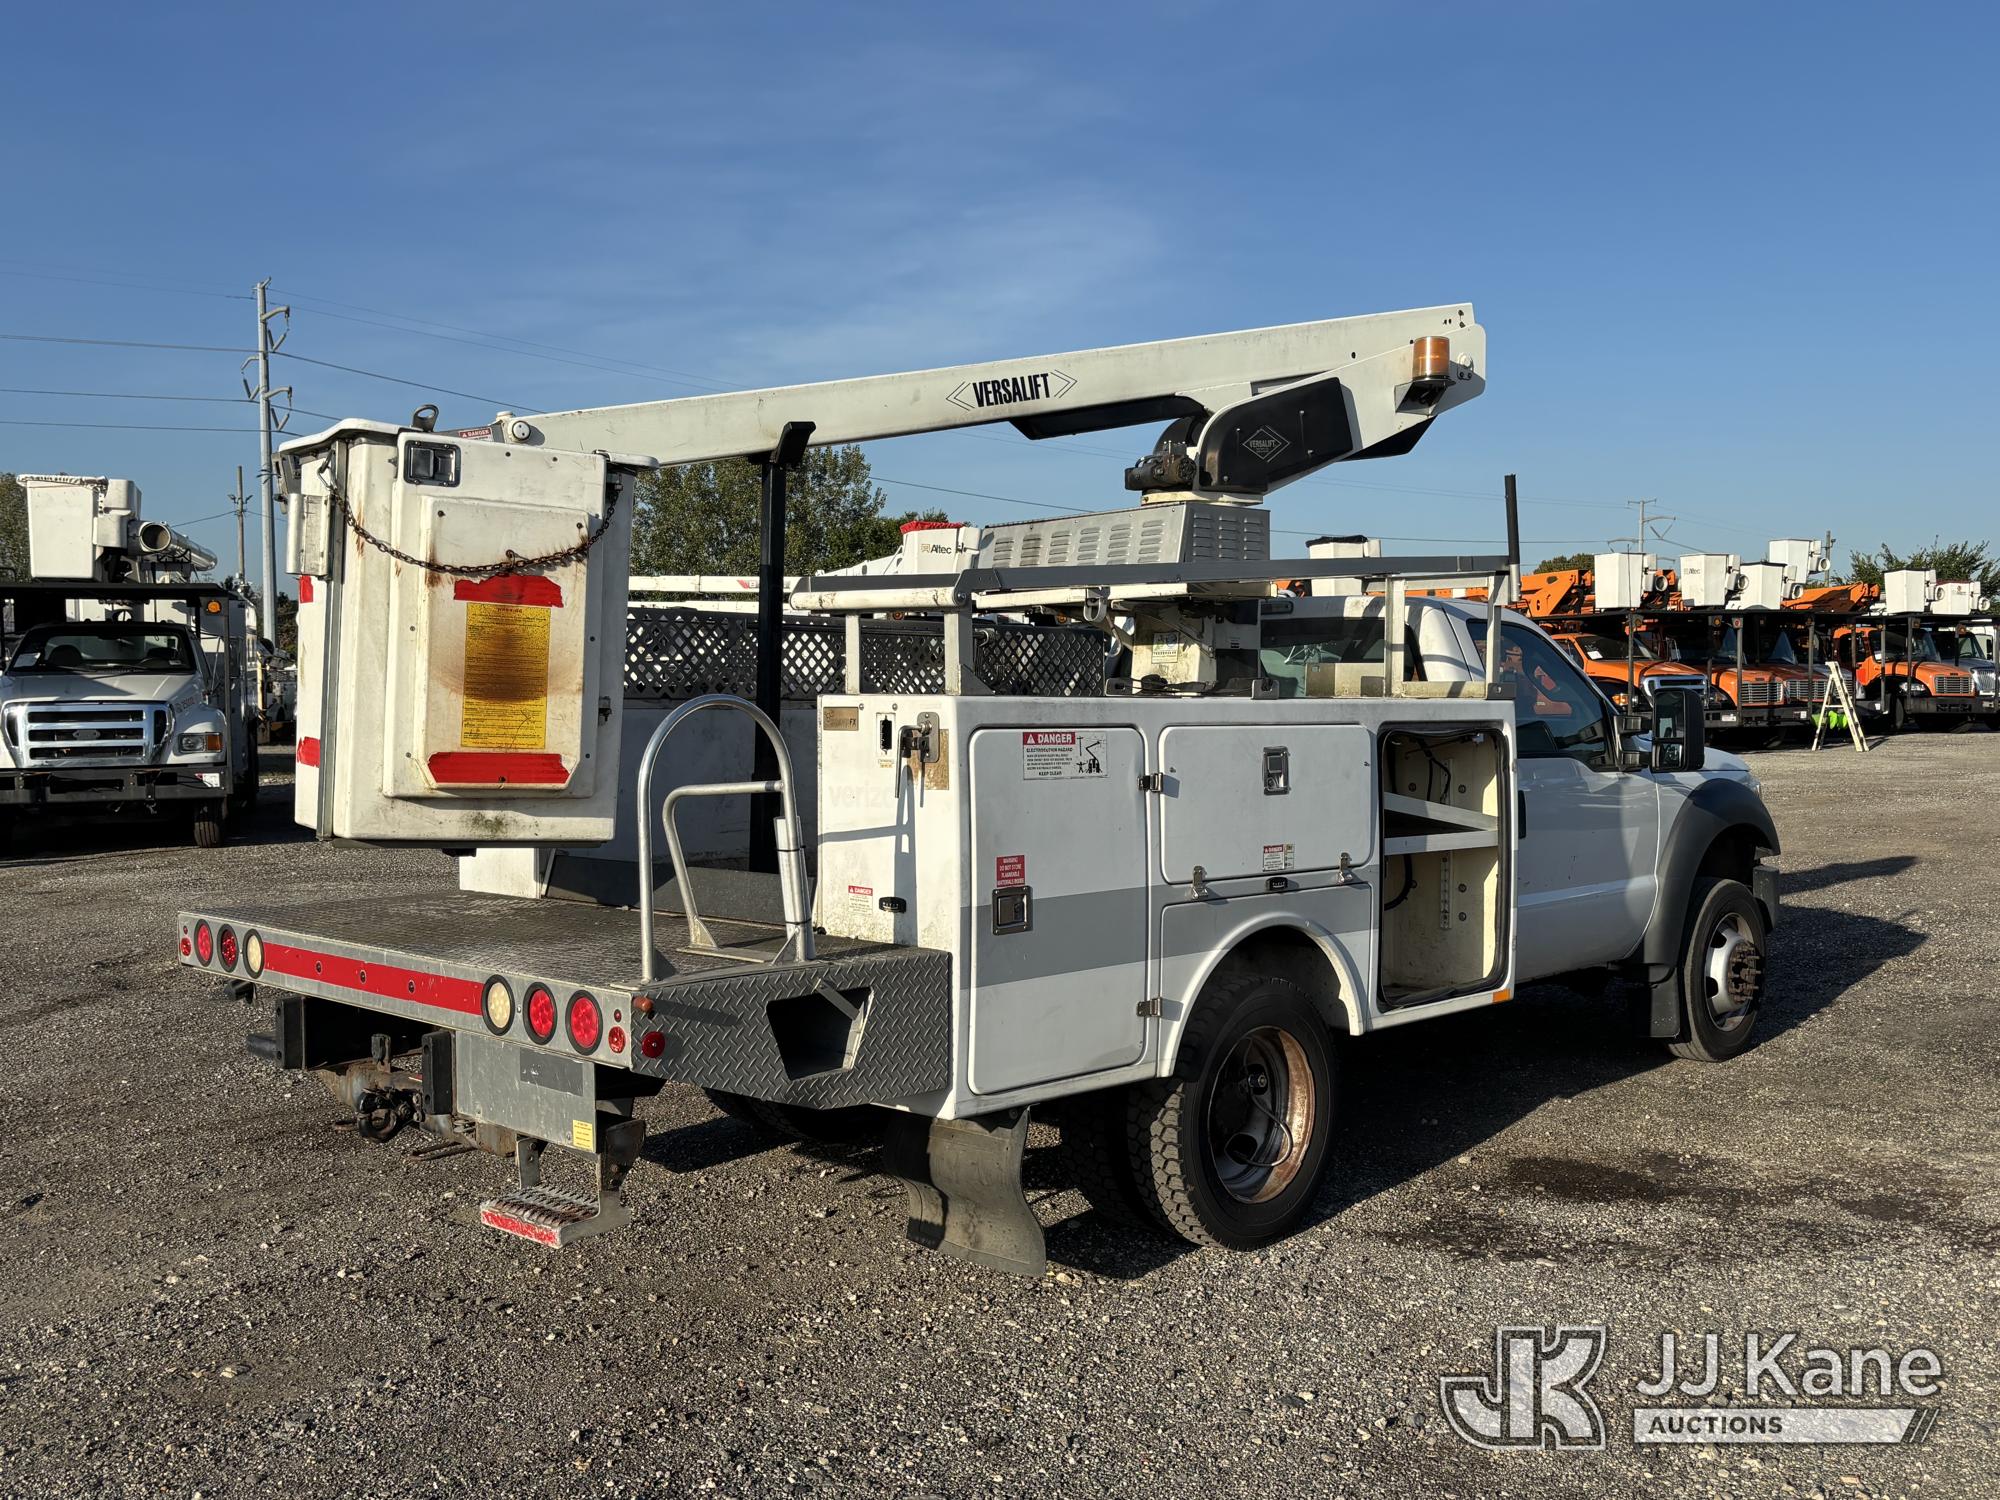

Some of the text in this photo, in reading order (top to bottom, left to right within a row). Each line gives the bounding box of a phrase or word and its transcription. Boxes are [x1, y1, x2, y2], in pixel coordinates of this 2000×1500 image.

[972, 373, 1050, 408] VERSALIFT
[930, 544, 952, 554] Altec
[1037, 733, 1073, 744] DANGER
[828, 779, 897, 808] verizo
